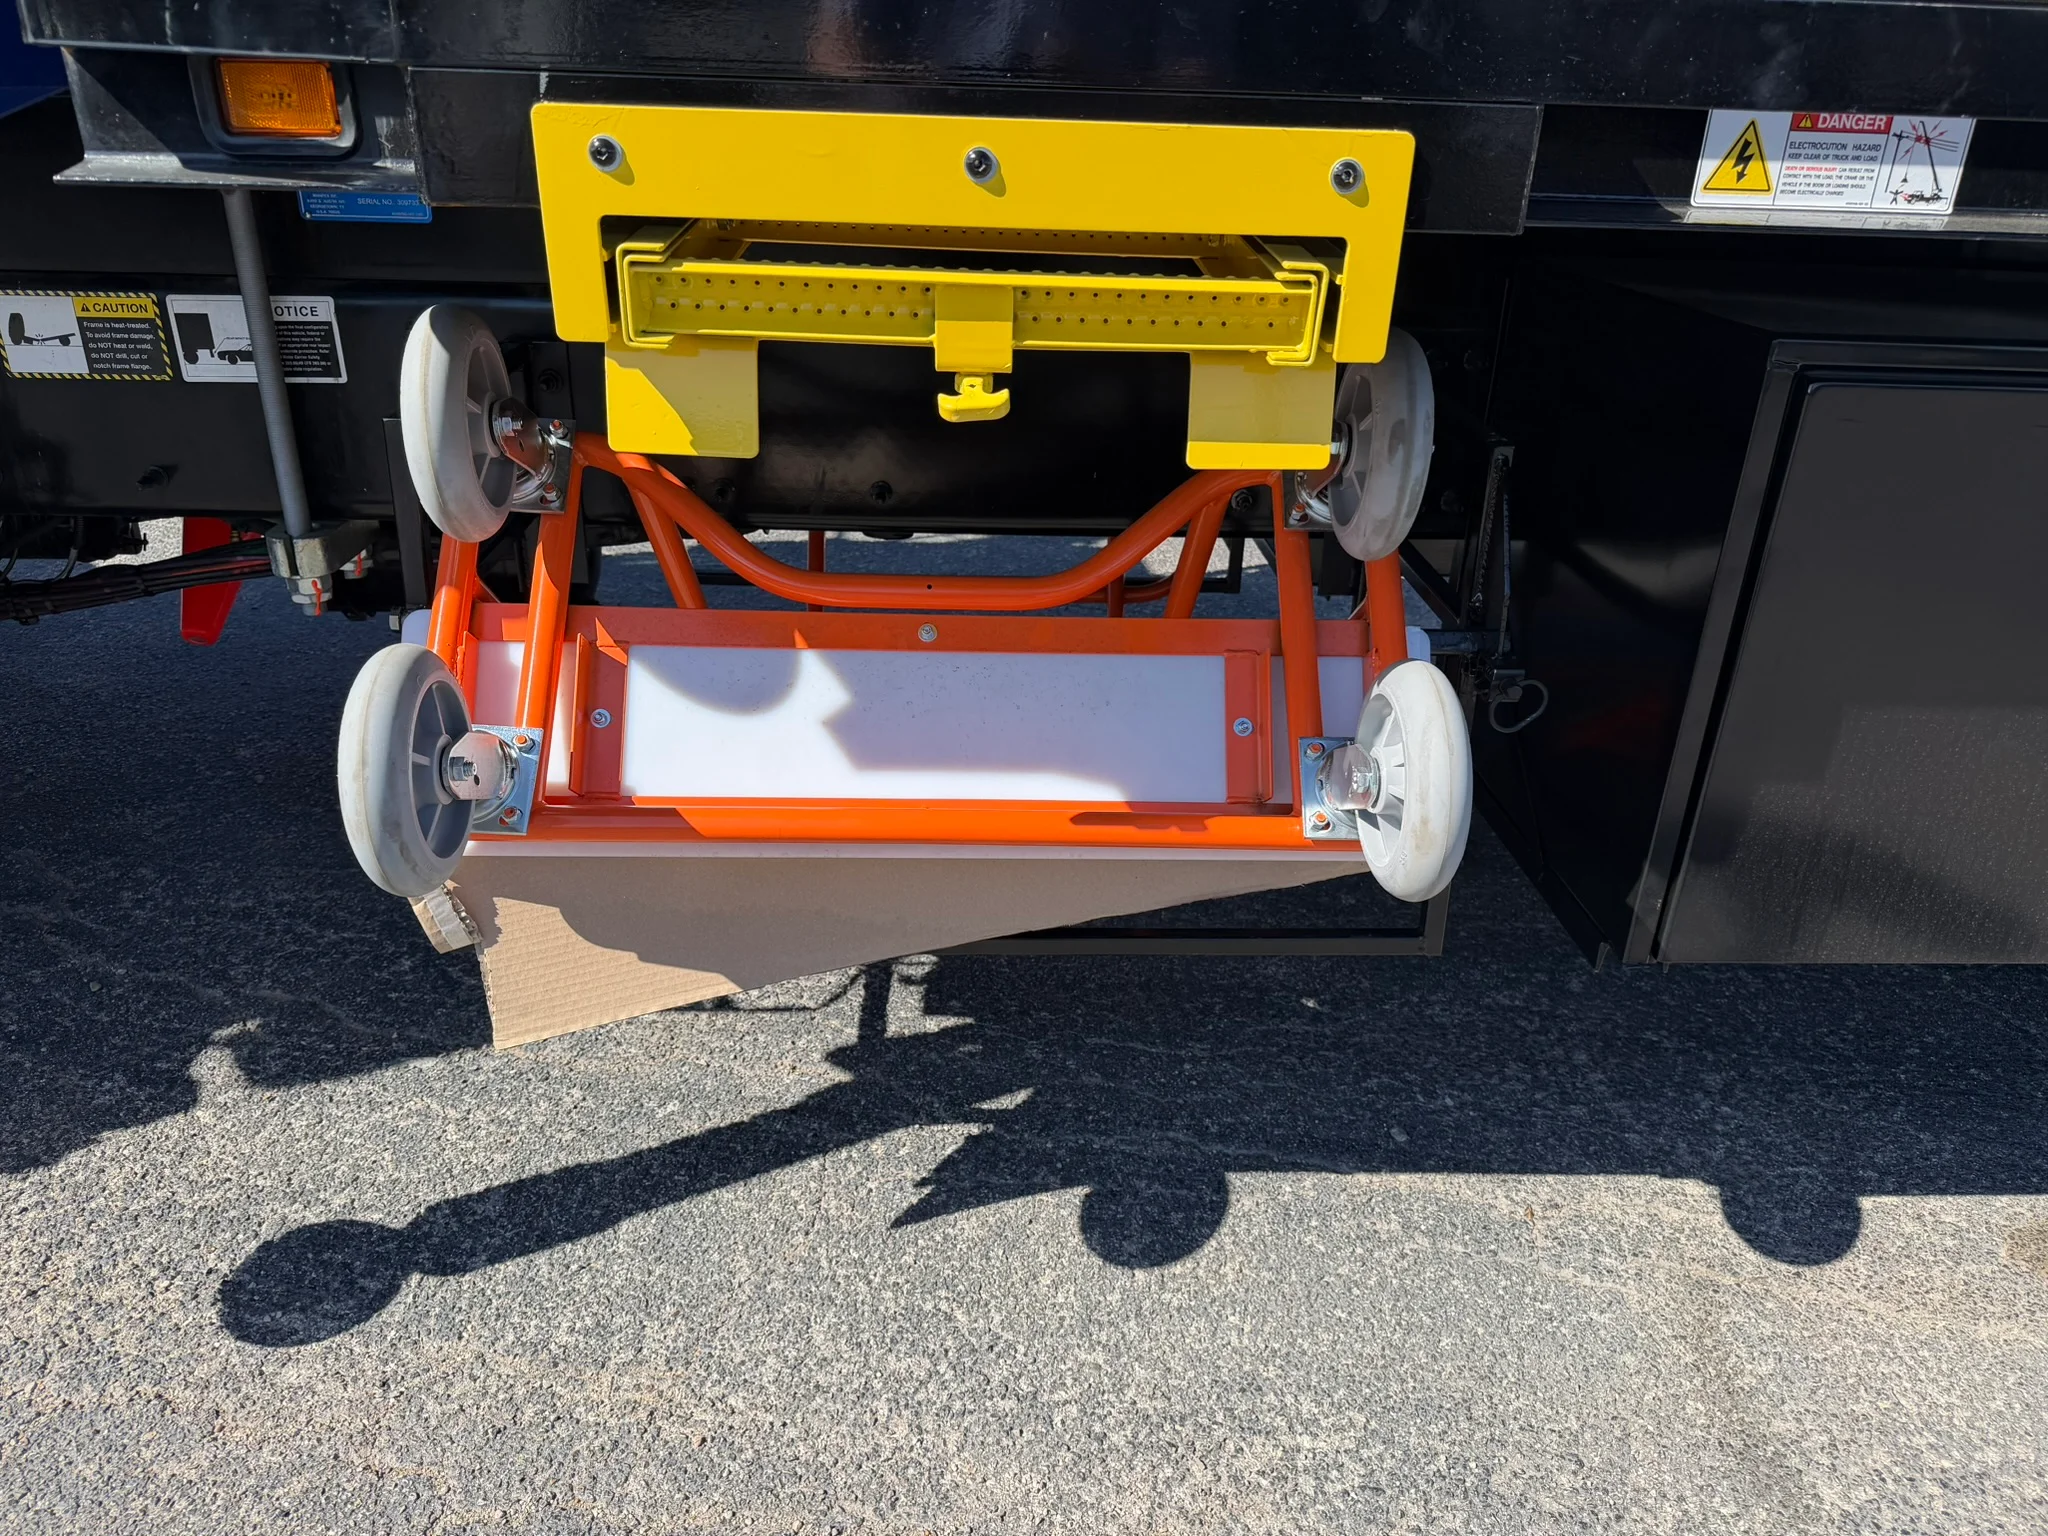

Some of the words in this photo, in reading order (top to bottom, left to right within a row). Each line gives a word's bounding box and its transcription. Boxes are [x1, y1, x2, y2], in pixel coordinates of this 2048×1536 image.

[1818, 113, 1886, 130] DANGER
[1789, 141, 1847, 151] ELECTROCUTION
[1852, 144, 1881, 152] HAZARD
[92, 303, 148, 313] CAUTION
[274, 306, 319, 316] OTICE
